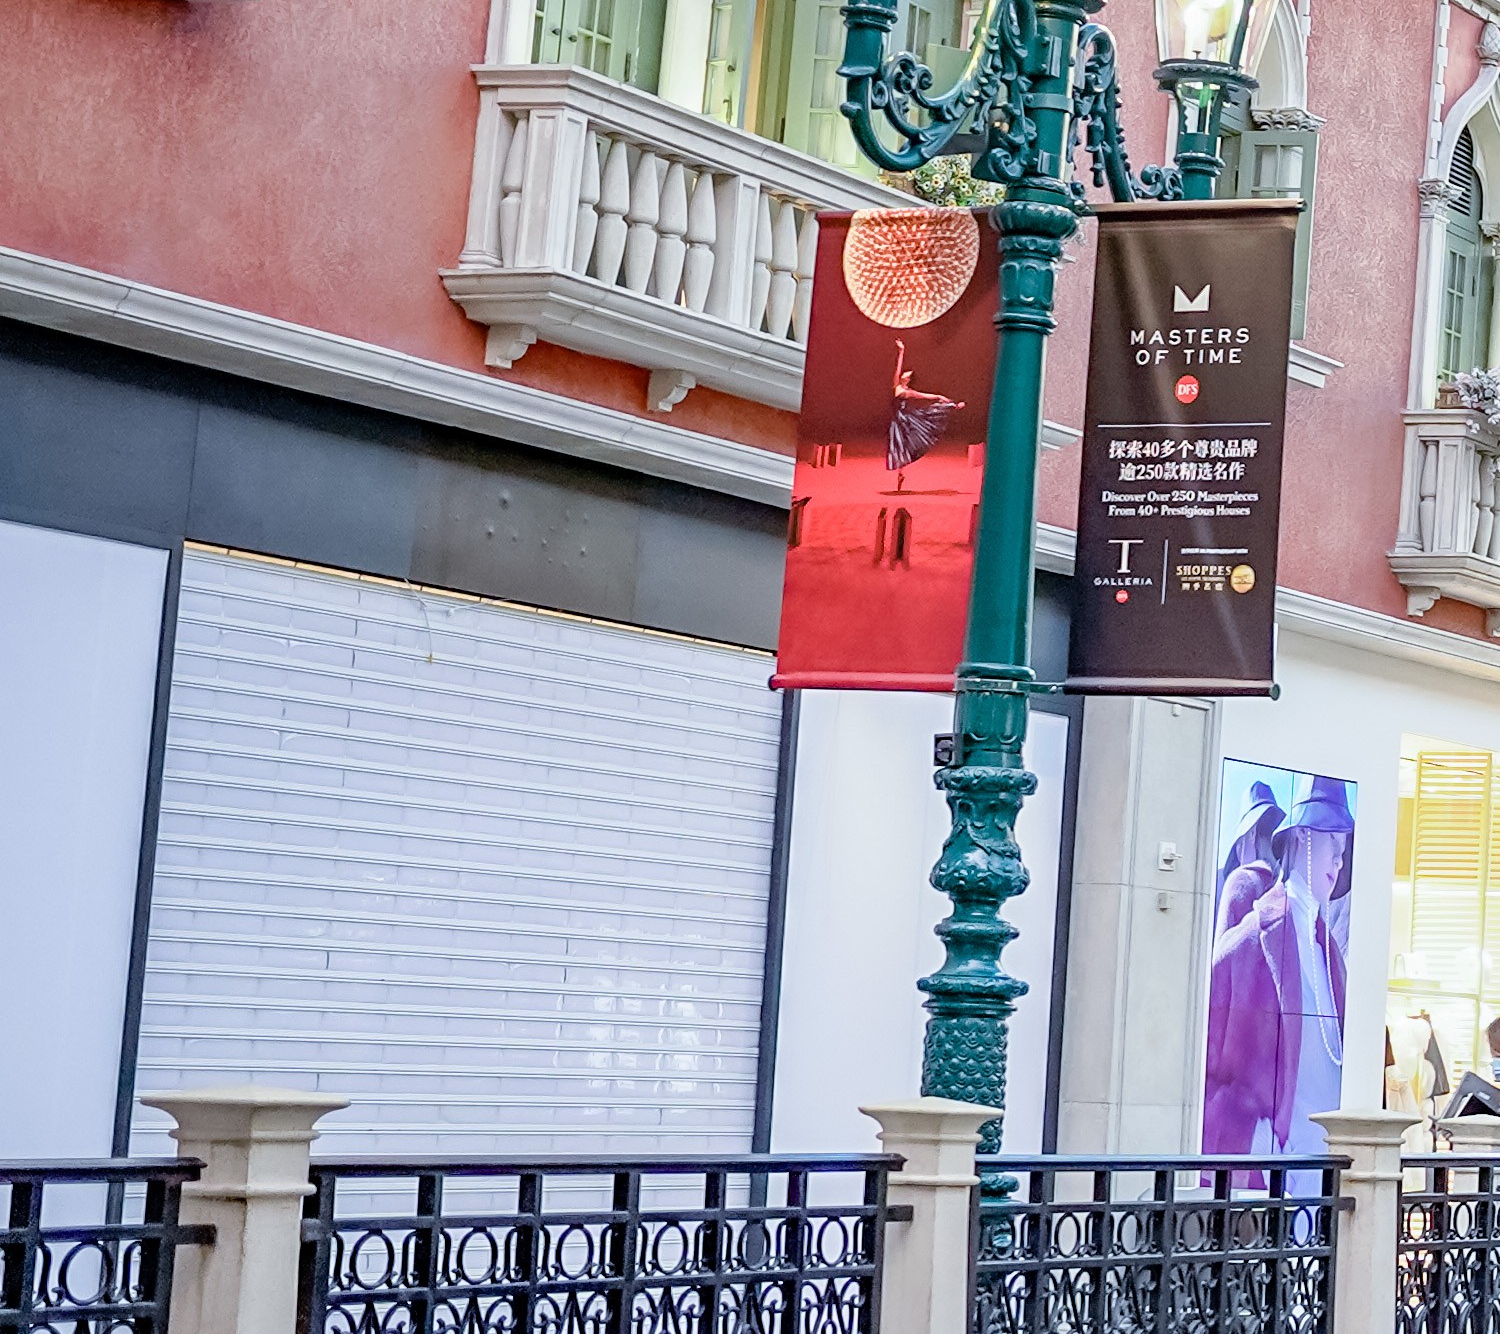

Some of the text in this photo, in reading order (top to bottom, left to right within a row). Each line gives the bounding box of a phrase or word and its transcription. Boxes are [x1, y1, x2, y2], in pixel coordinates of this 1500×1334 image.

[1130, 327, 1250, 345] MASTERS
[1135, 348, 1242, 366] OF TIME
[1177, 383, 1199, 396] DFS
[1108, 439, 1258, 459] 探索40多个尊贵品牌
[1101, 490, 1259, 504] Discover Over 250 Masterpieces
[1108, 504, 1136, 517] From
[1160, 504, 1215, 518] Prestigious
[1216, 505, 1251, 516] Houses
[1108, 539, 1144, 574] T
[1176, 565, 1232, 576] SHOPPES
[1093, 577, 1153, 586] GALLERIA
